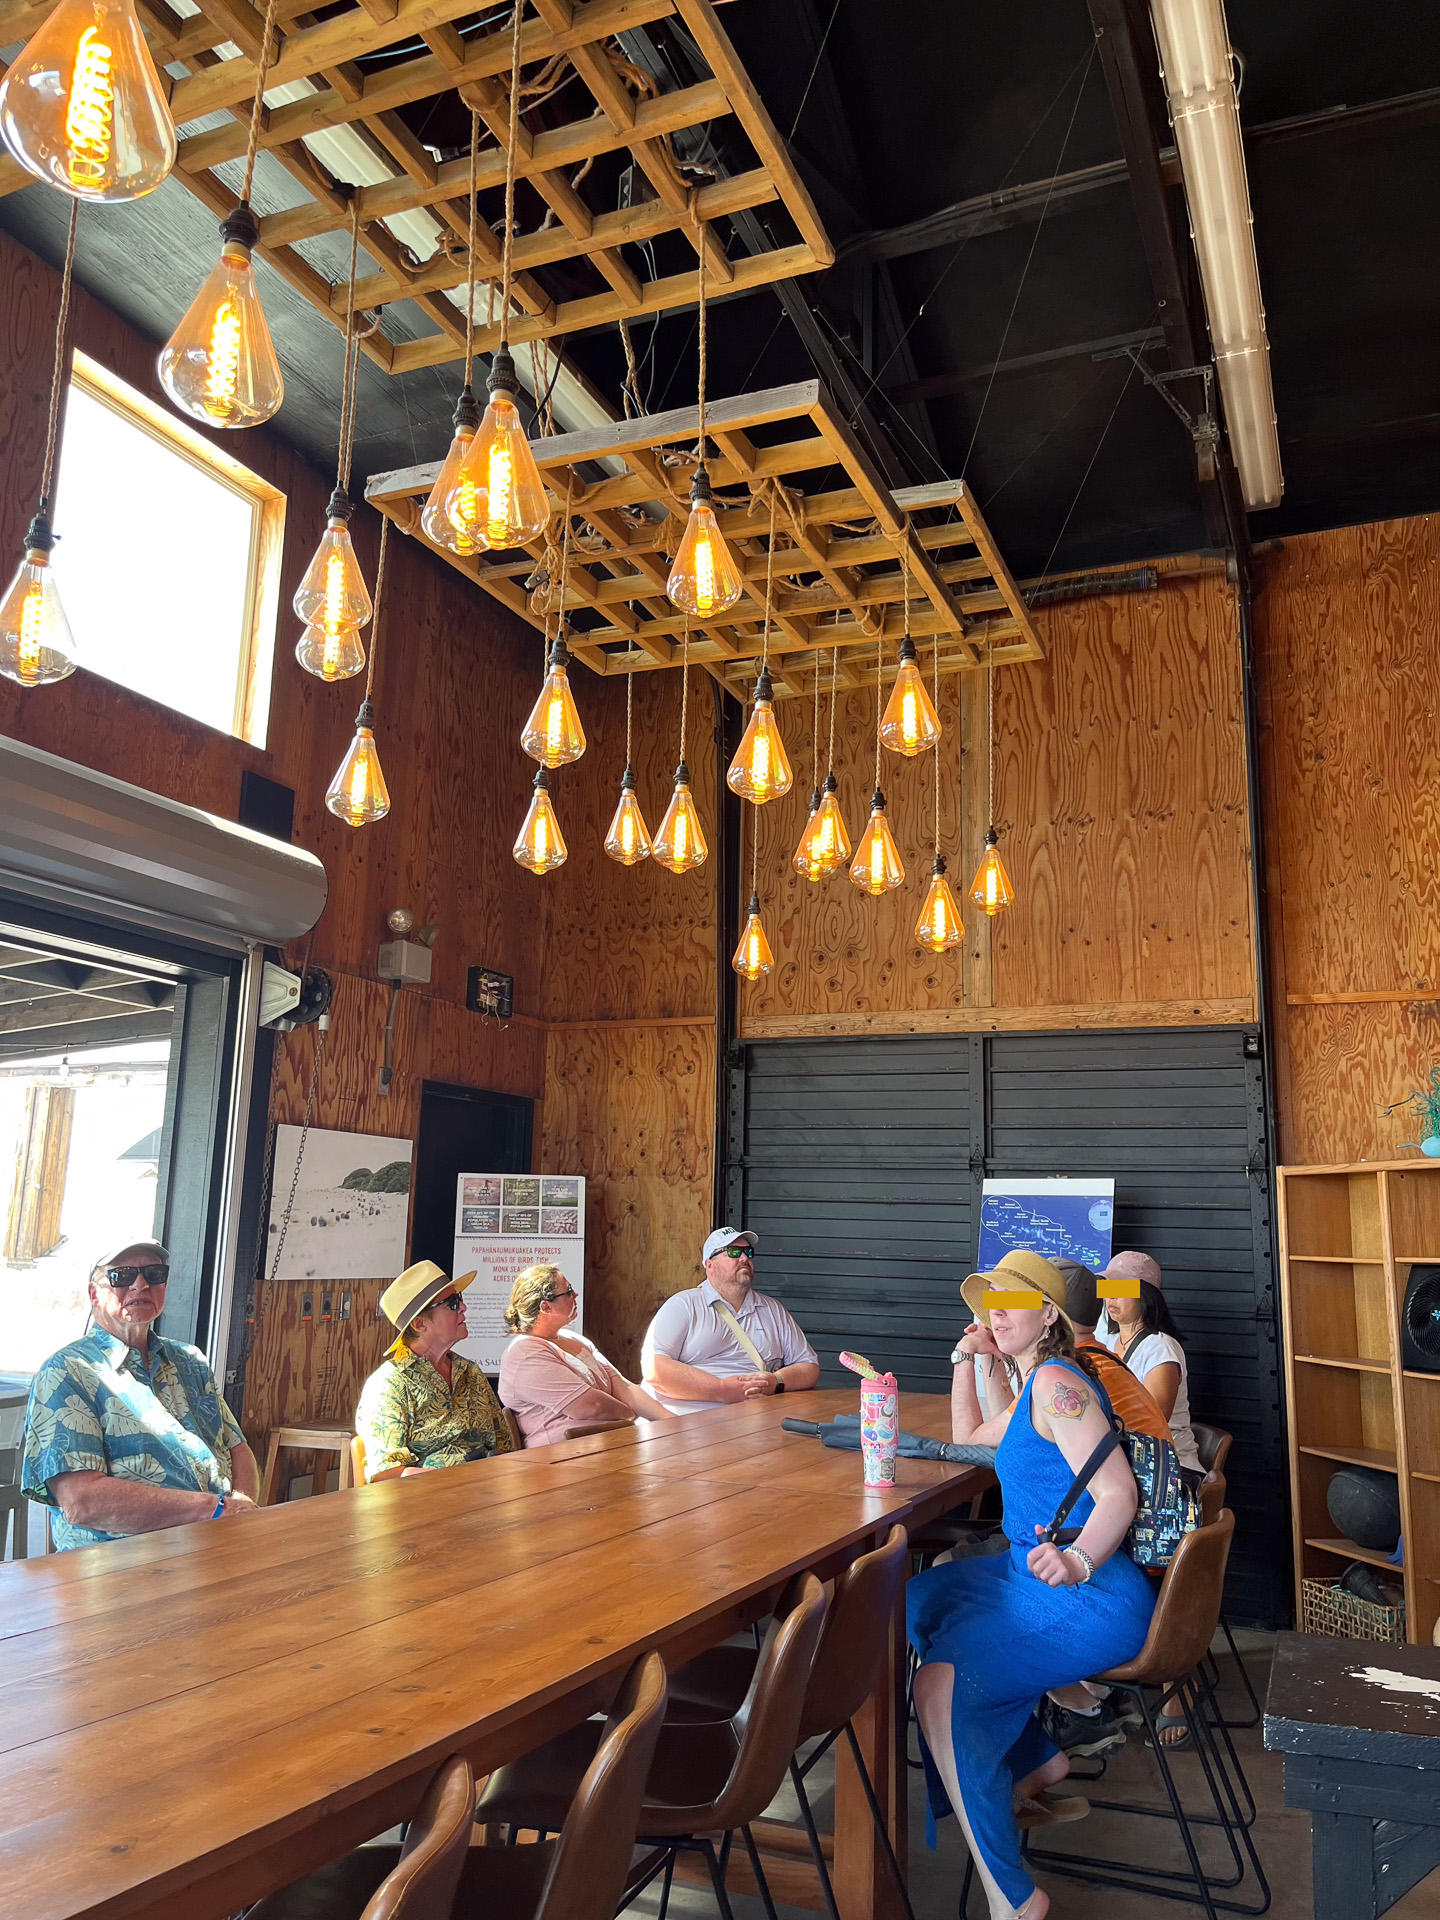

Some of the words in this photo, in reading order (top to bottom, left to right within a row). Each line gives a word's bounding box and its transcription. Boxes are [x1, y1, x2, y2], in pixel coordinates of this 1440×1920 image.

[534, 1247, 562, 1255] PROTECTS
[482, 1256, 508, 1264] MILLIONS
[509, 1256, 516, 1264] OF
[492, 1265, 509, 1273] MONK
[493, 1275, 511, 1283] ACRES
